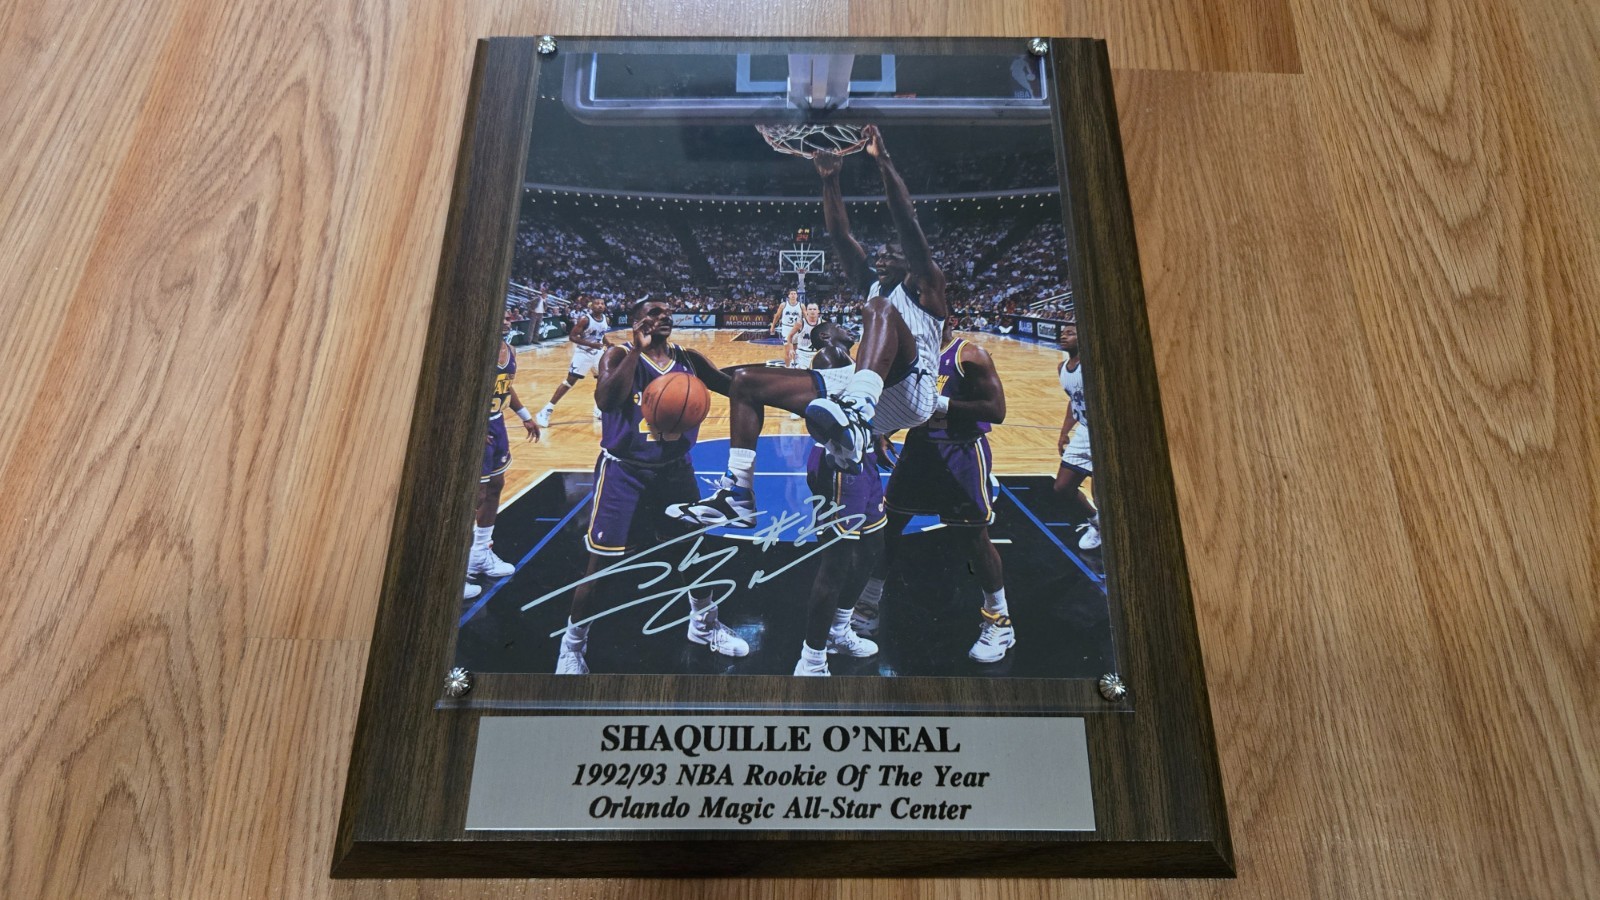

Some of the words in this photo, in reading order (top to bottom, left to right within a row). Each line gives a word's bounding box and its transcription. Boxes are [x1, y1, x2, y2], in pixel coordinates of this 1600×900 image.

[601, 724, 812, 758] SHAQUILLE
[822, 725, 961, 753] O'NEAL
[571, 763, 668, 790] 1992/93
[675, 763, 734, 787] NBA
[743, 763, 828, 787] Rookie
[836, 763, 872, 793] Of
[878, 764, 923, 787] The
[933, 765, 991, 788] Year
[588, 795, 691, 820] Orlando
[698, 796, 776, 825] Magic
[782, 796, 882, 820] All-Star
[890, 796, 972, 820] Center
